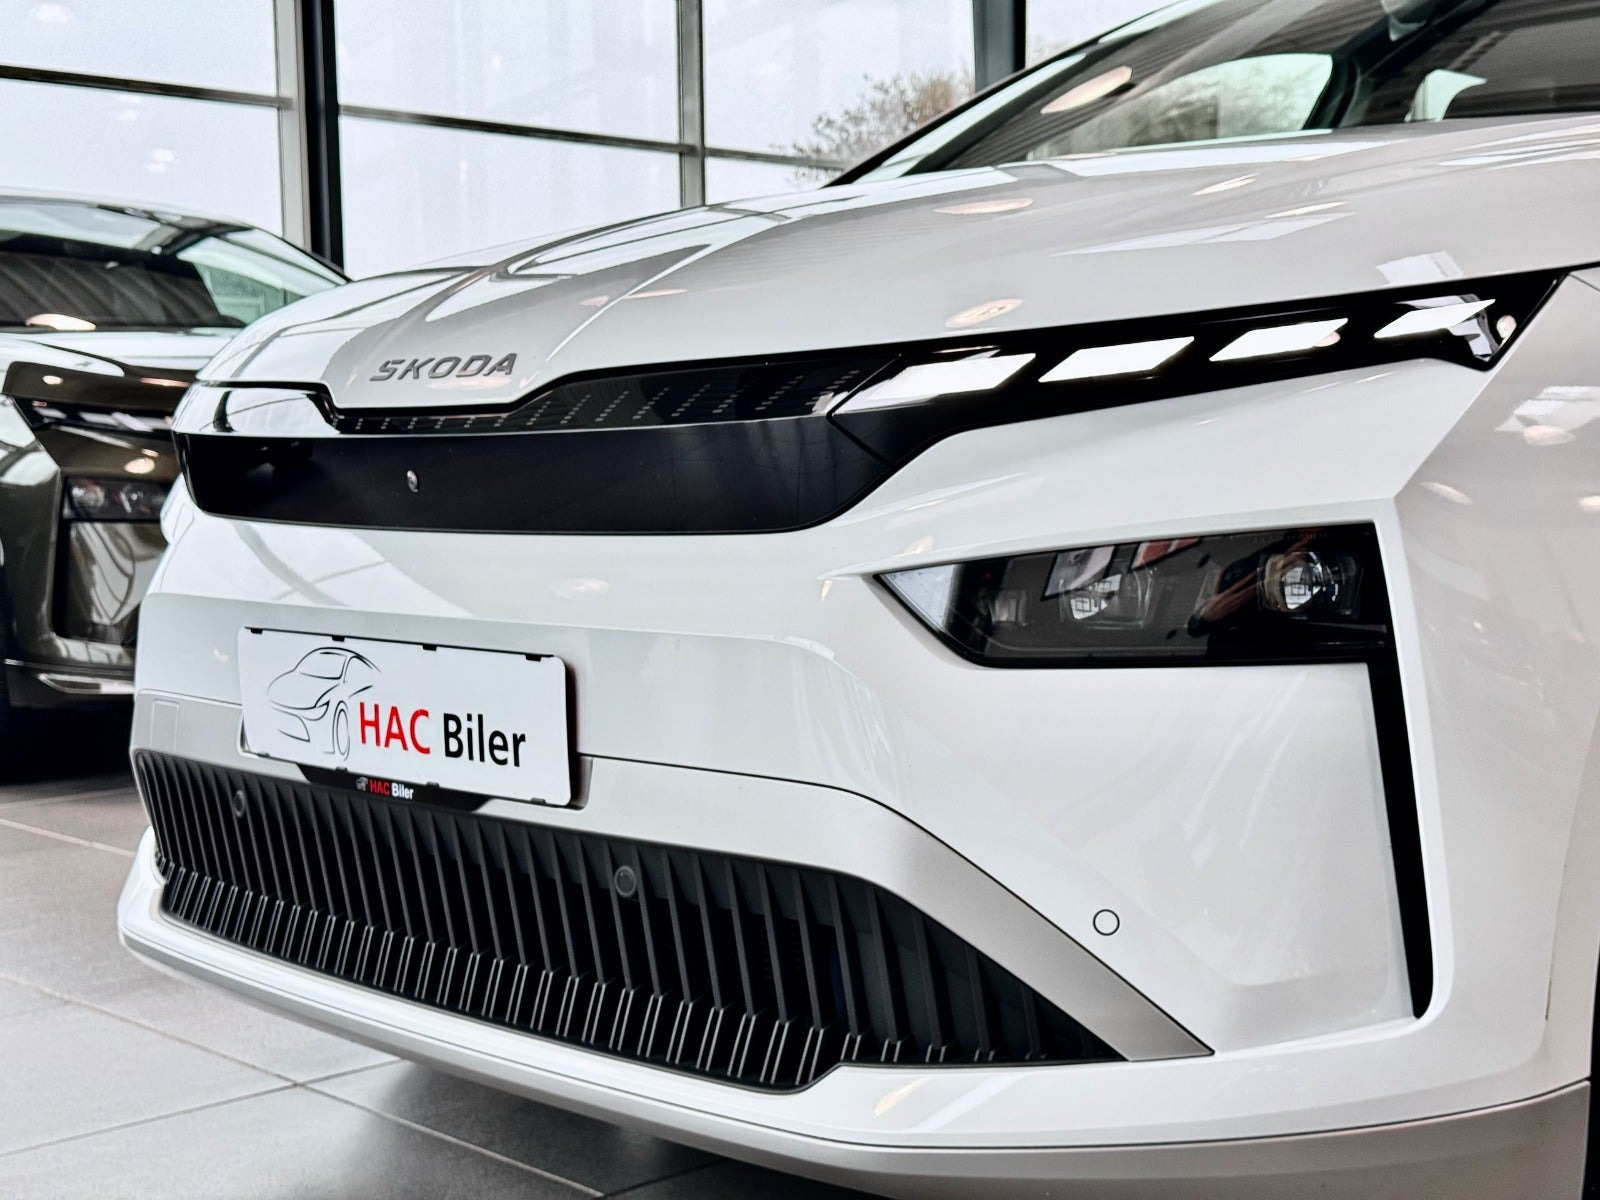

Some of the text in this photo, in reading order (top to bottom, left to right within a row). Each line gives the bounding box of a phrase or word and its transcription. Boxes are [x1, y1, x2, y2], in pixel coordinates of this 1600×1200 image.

[369, 353, 518, 382] SKODA
[359, 702, 526, 767] HAC Biler
[369, 779, 414, 800] HAC Biler
